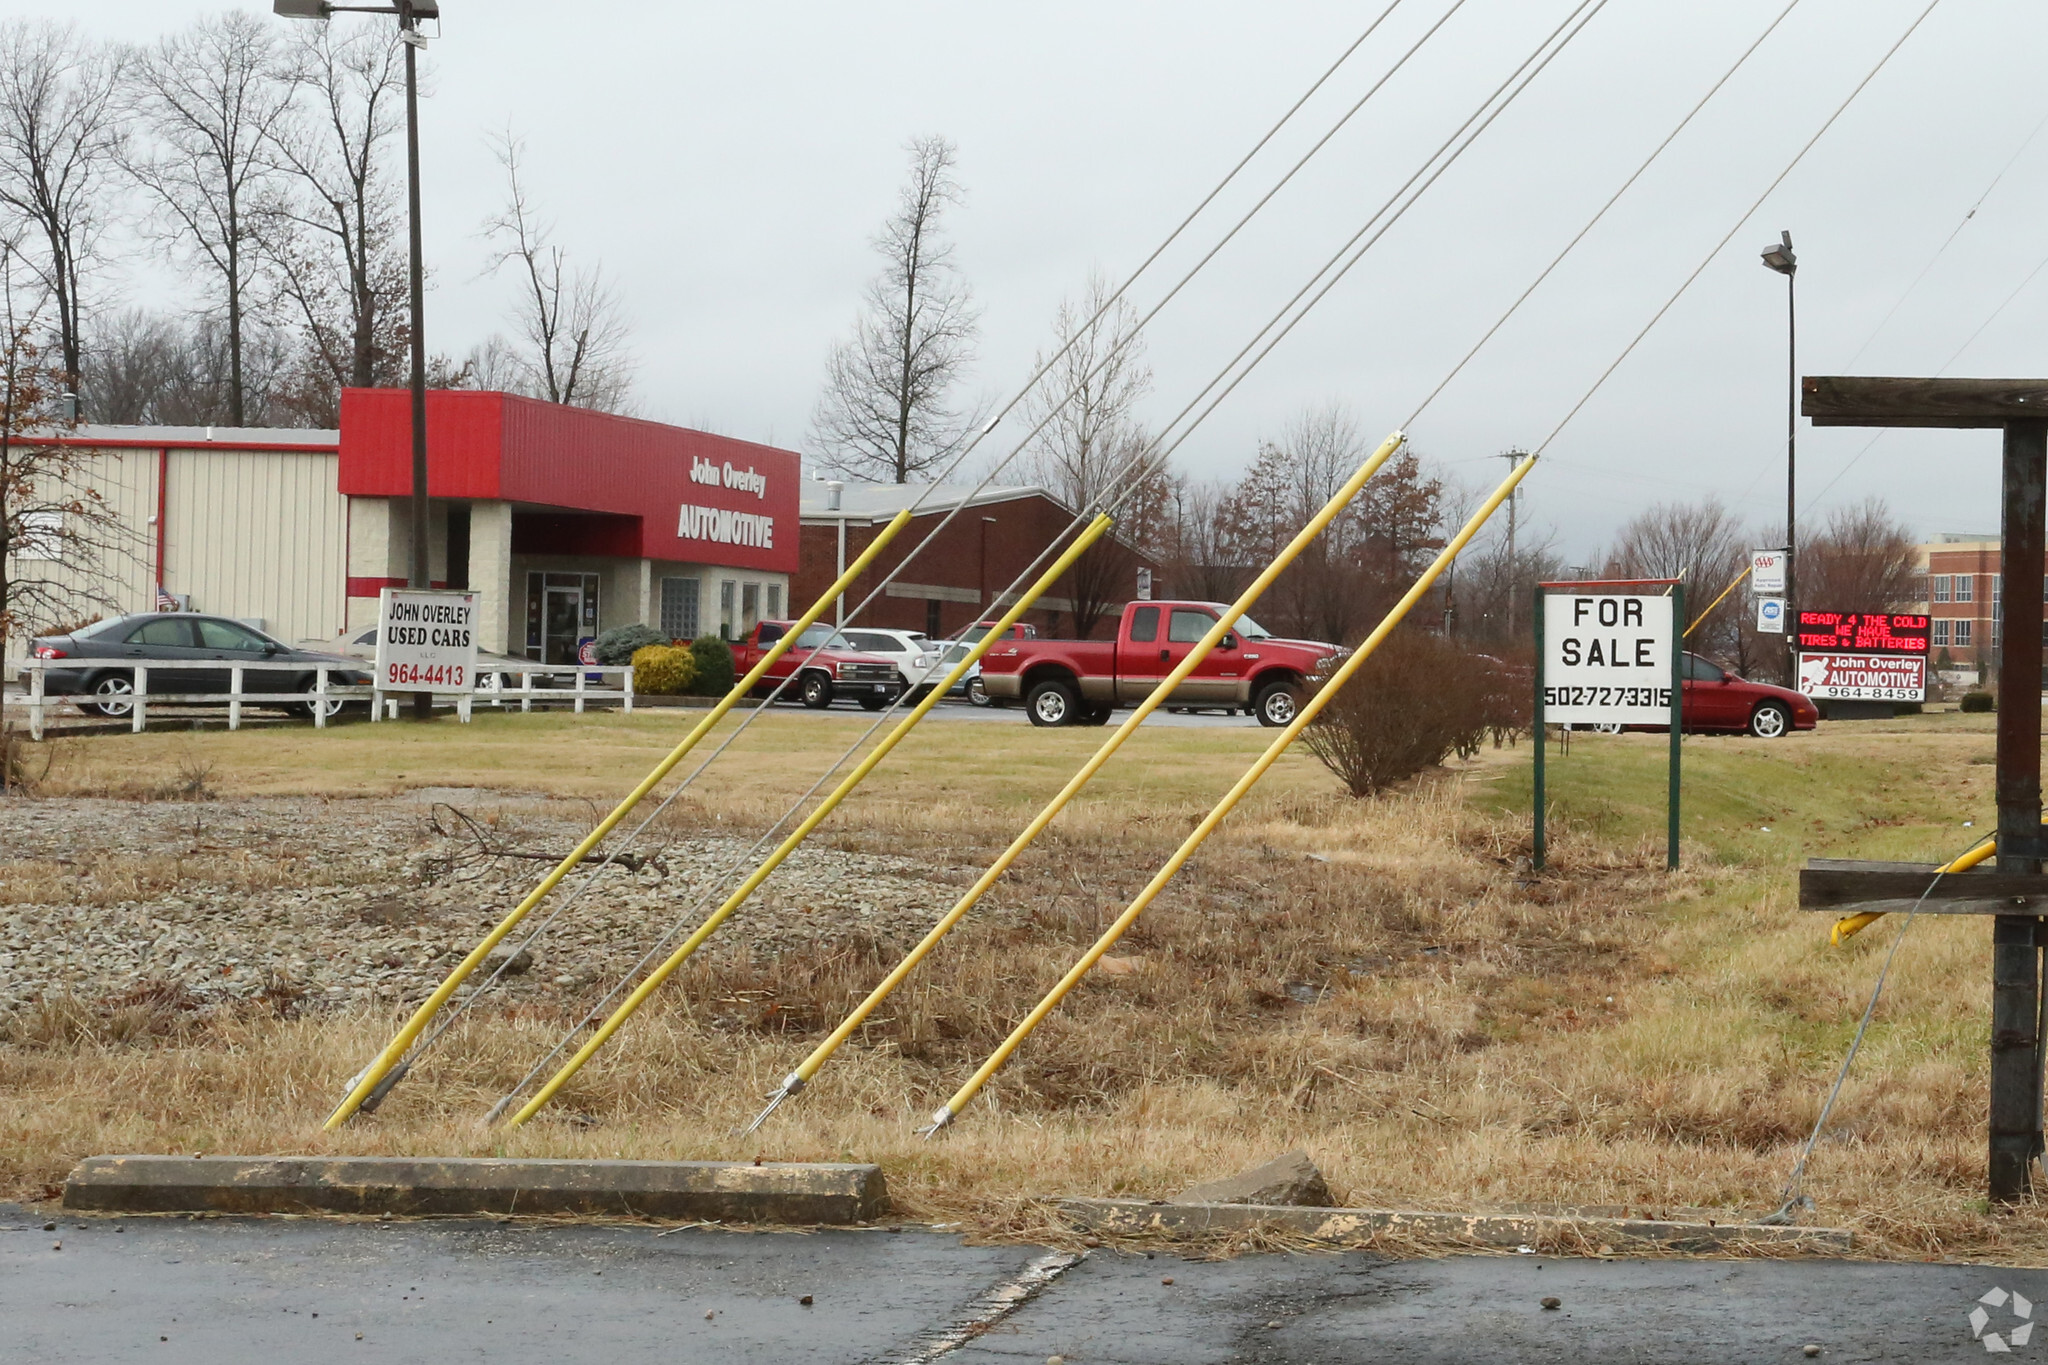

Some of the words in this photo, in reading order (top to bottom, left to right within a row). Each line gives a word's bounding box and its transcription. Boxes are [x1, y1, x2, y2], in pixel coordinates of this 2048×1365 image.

[690, 455, 720, 486] John
[722, 461, 767, 499] Overley
[677, 504, 774, 550] AUTOMOTIVE
[389, 602, 419, 621] JOHN
[422, 604, 471, 625] OVERLEY
[1574, 598, 1643, 627] FOR
[1800, 612, 1842, 625] READY
[1847, 614, 1857, 625] 4
[1862, 615, 1888, 627] THE
[1893, 616, 1927, 629] COLD
[388, 626, 427, 645] USED
[431, 628, 470, 647] CARS
[1835, 625, 1853, 636] WE
[1858, 626, 1891, 638] HAVE
[1799, 634, 1837, 647] TIRES
[1841, 638, 1850, 647] &
[1855, 637, 1926, 650] BATTERIES
[1562, 638, 1655, 667] SALE
[389, 663, 464, 686] 964-4413
[1831, 657, 1866, 669] John
[1869, 658, 1921, 672] Overley
[1829, 670, 1919, 688] AUTOMOTIVE
[1544, 687, 1672, 707] 502-727-3315
[1828, 687, 1919, 700] 964-8459
